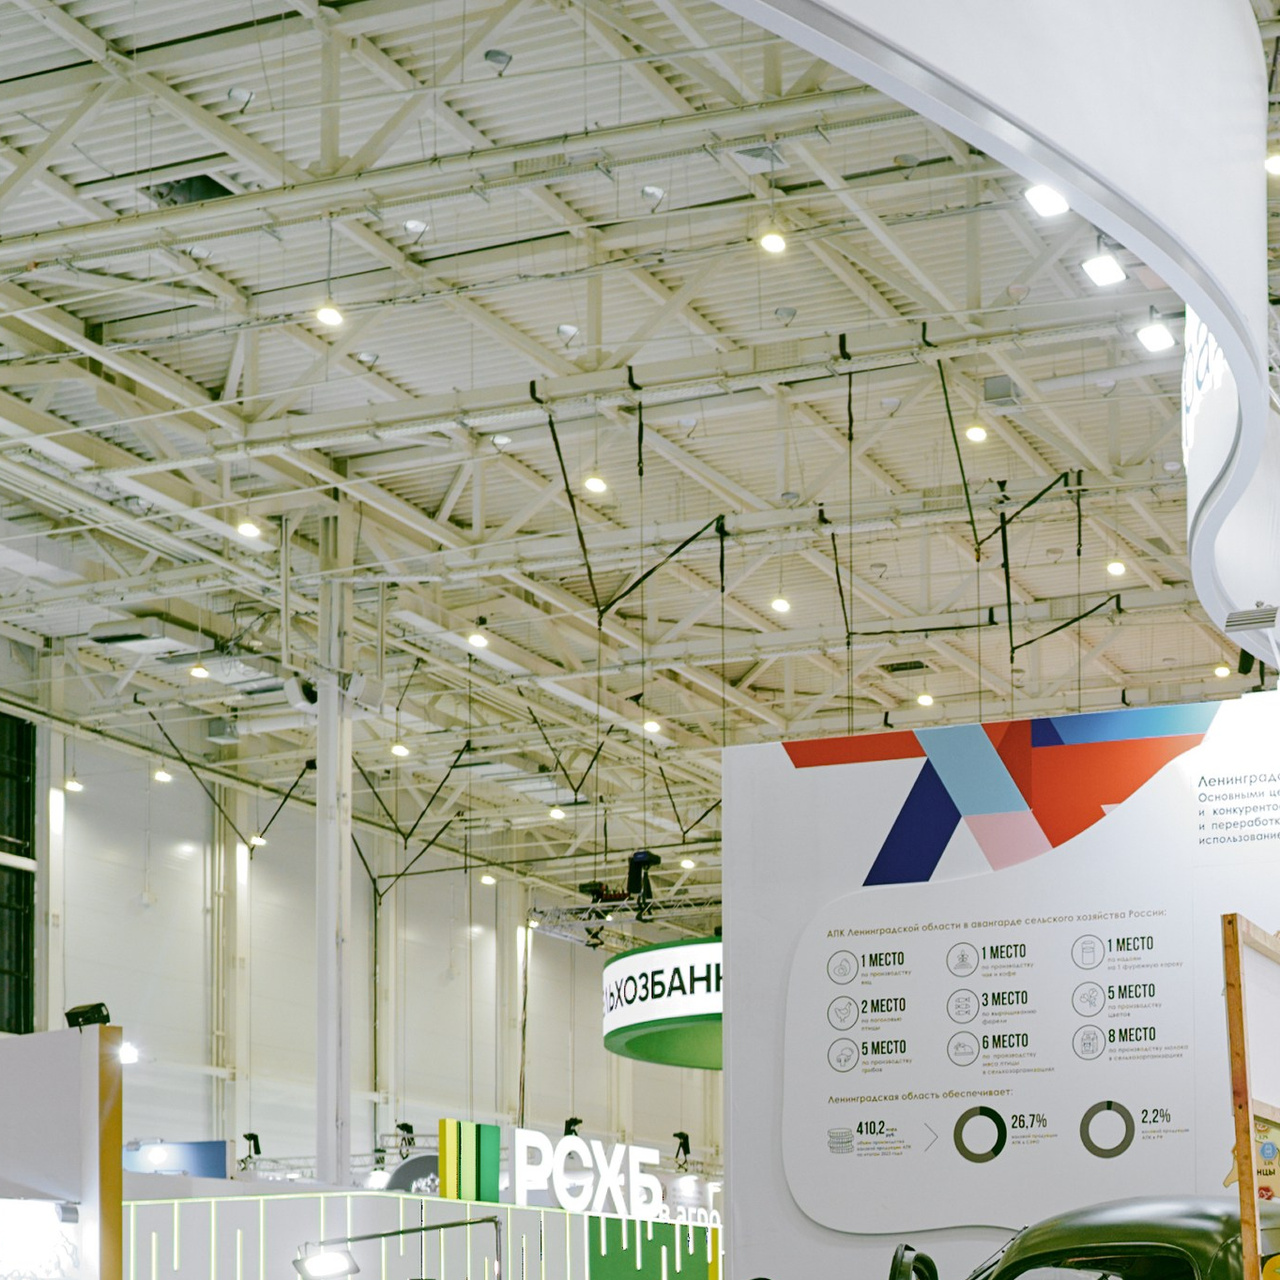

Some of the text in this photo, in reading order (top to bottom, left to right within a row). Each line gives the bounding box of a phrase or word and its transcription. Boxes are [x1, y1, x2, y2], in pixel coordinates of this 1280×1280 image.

[1198, 789, 1265, 803] Основными
[1198, 809, 1205, 817] и
[1198, 823, 1205, 831] и
[827, 928, 846, 938] АПК
[847, 923, 920, 939] Ленинградской
[922, 920, 962, 932] области
[971, 917, 1022, 931] авангарде
[1024, 914, 1074, 926] сельского
[1076, 911, 1127, 922] хозяйства
[982, 944, 1026, 960] 1 МЕСТО
[1107, 936, 1155, 952] 1 МЕСТО
[861, 952, 905, 967] 1 МЕСТО
[982, 991, 1028, 1007] 3 МЕСТО
[1108, 983, 1156, 1000] 5 МЕСТО
[861, 998, 907, 1014] 2 МЕСТО
[982, 1033, 1029, 1049] 6 МЕСТО
[1108, 1027, 1157, 1043] 8 МЕСТО
[862, 1040, 907, 1056] 5 МЕСТО
[828, 1088, 1014, 1106] Ленинградская область обеспечивает:
[1011, 1113, 1048, 1130] 26,7%
[1141, 1109, 1172, 1126] 2,2%
[856, 1121, 885, 1137] 410,2
[515, 1128, 663, 1219] РСХБ
